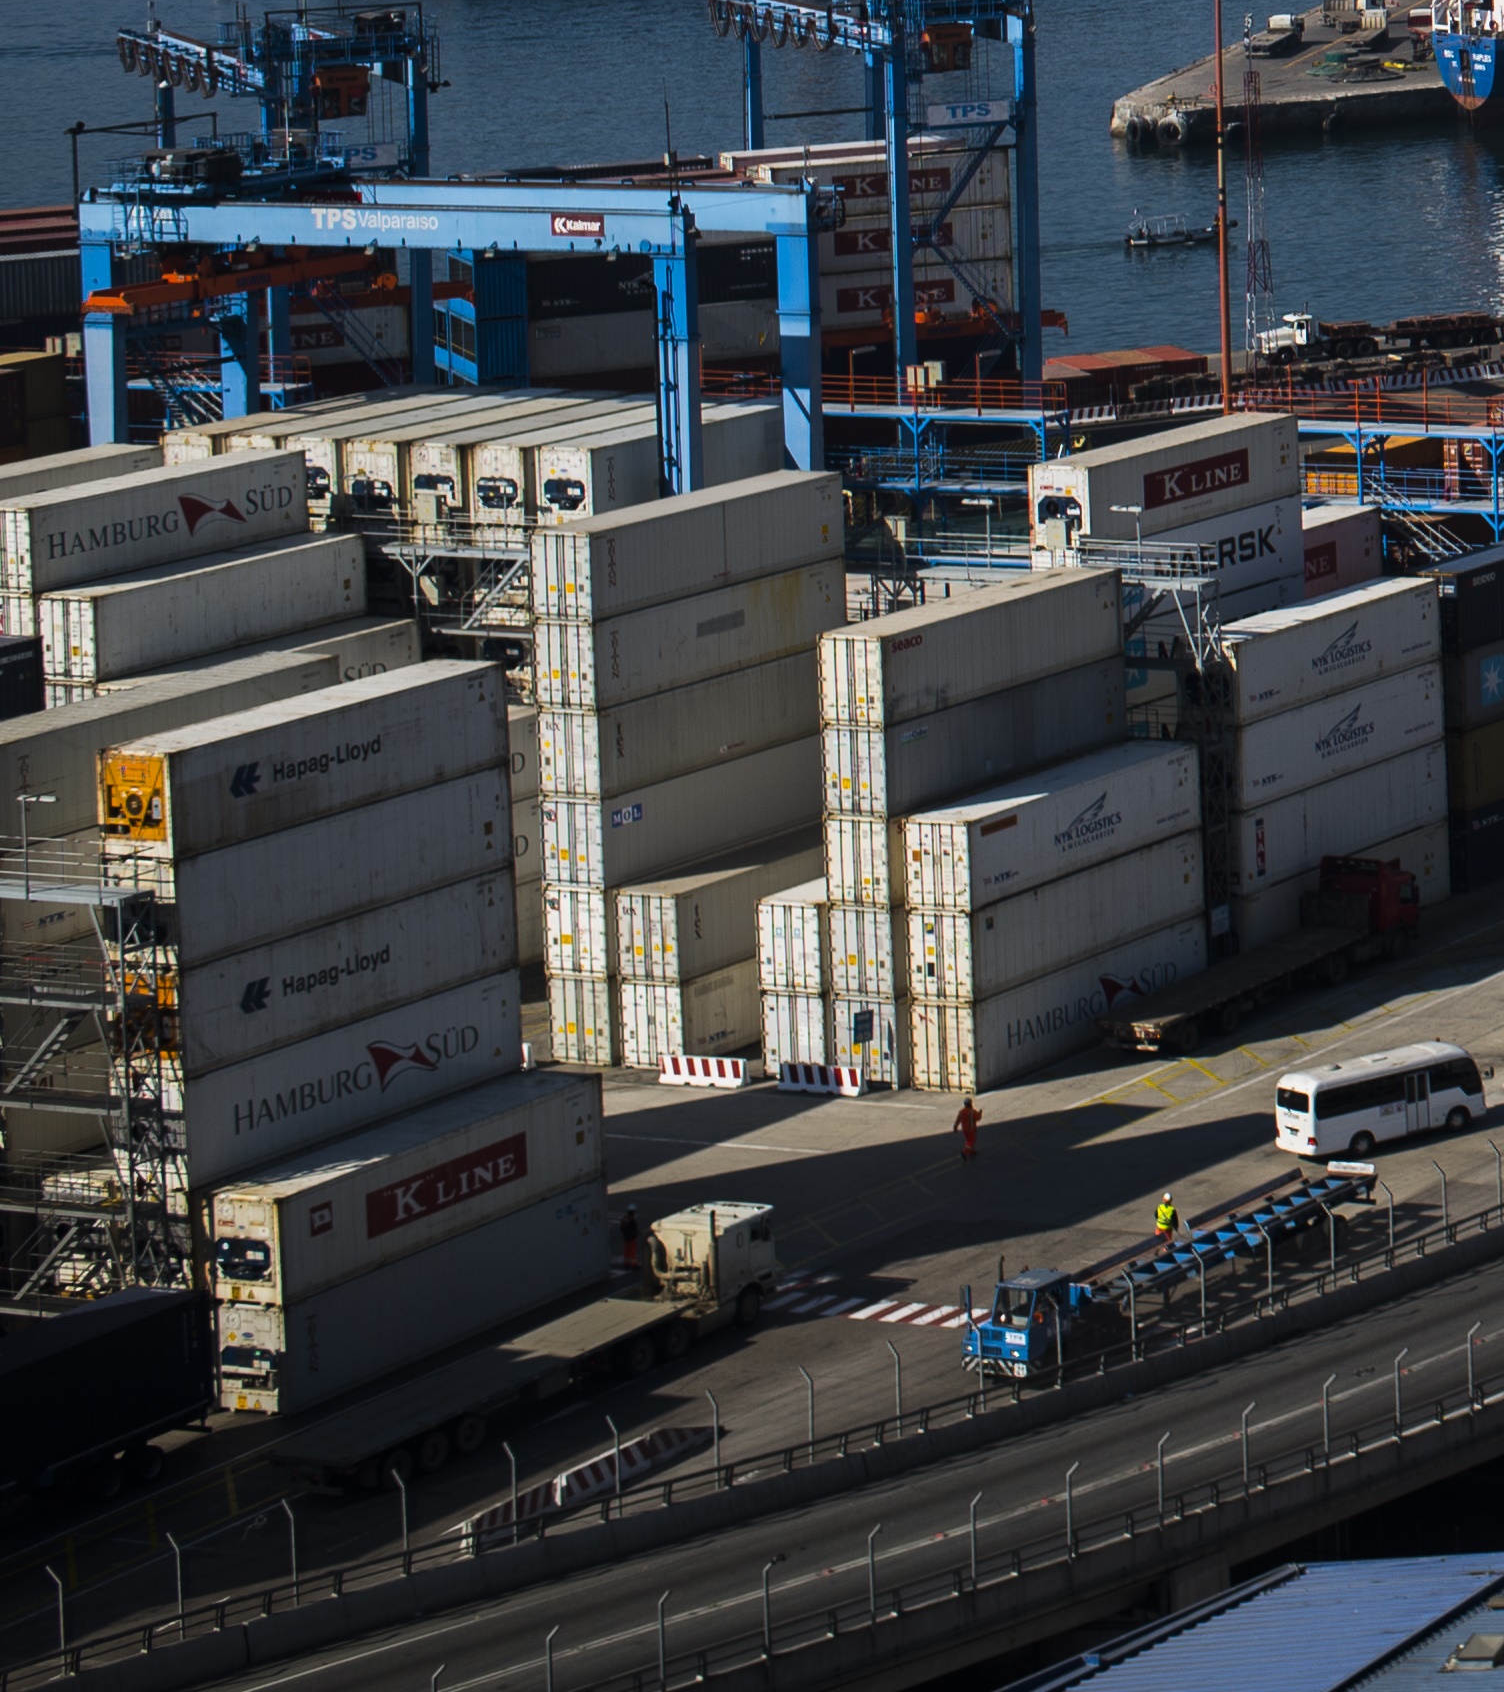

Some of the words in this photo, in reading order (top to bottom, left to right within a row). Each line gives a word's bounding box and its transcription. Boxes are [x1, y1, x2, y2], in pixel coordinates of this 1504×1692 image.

[945, 101, 992, 119] TPS
[311, 208, 356, 231] TPS
[1190, 462, 1242, 491] LINE
[48, 510, 179, 559] HAMBURG
[246, 485, 292, 515] SÜD
[891, 634, 923, 653] seaco
[1311, 655, 1331, 670] NYK
[1331, 640, 1372, 667] LOGISTICS
[1314, 737, 1333, 753] NYK
[1333, 722, 1375, 748] LOGISTICS
[272, 734, 382, 783] Hapag-Lloyd
[611, 804, 643, 827] MOL
[1054, 827, 1073, 846] NYK
[1075, 811, 1123, 838] LOGISTICS
[282, 944, 391, 998] Hapag-Lloyd
[1006, 990, 1104, 1050] HAMBURG
[1140, 961, 1178, 992] SÜD
[234, 1062, 372, 1135] HAMBURG
[426, 1025, 479, 1064] SÜD
[437, 1152, 517, 1205] LINE
